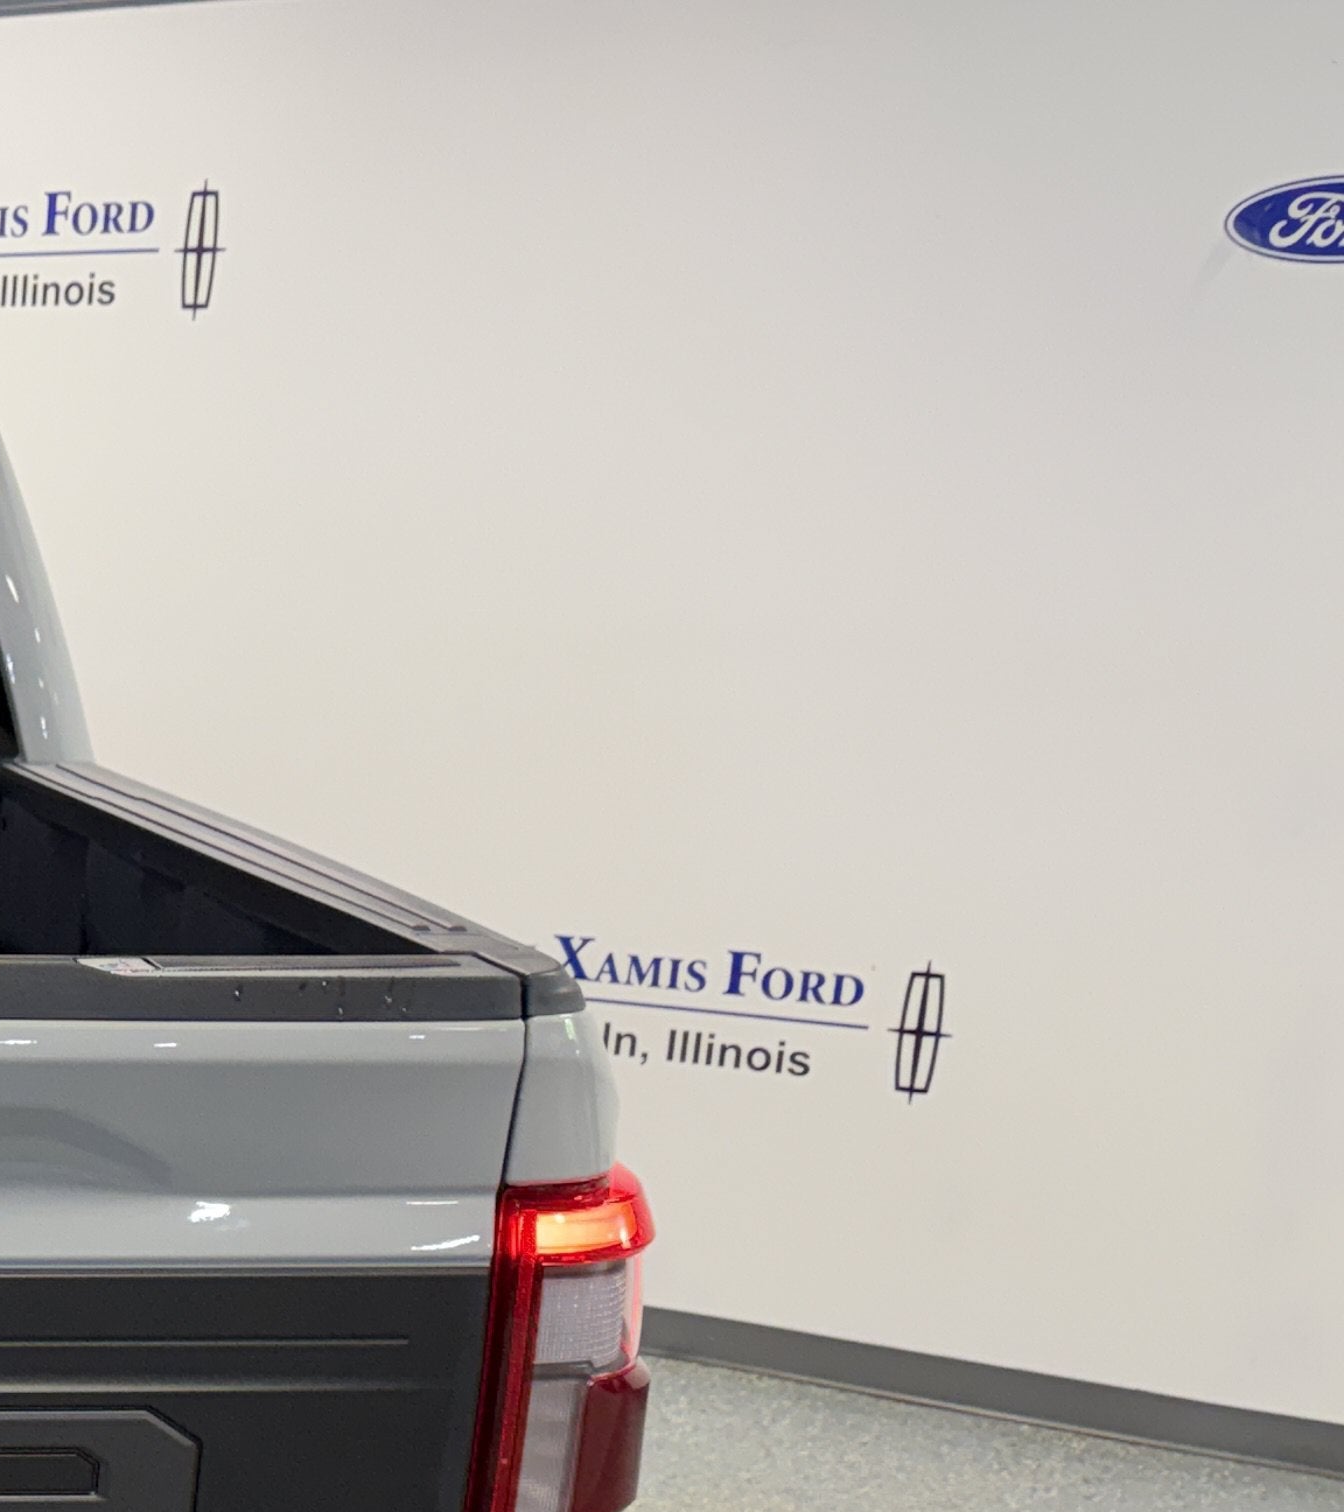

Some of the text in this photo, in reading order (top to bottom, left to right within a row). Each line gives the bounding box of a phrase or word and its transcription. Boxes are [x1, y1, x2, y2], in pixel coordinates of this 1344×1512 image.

[42, 191, 155, 236] FORD
[0, 272, 117, 308] Illinois
[554, 934, 865, 1007] XAMIS FORD
[666, 1029, 812, 1077] Illinois
